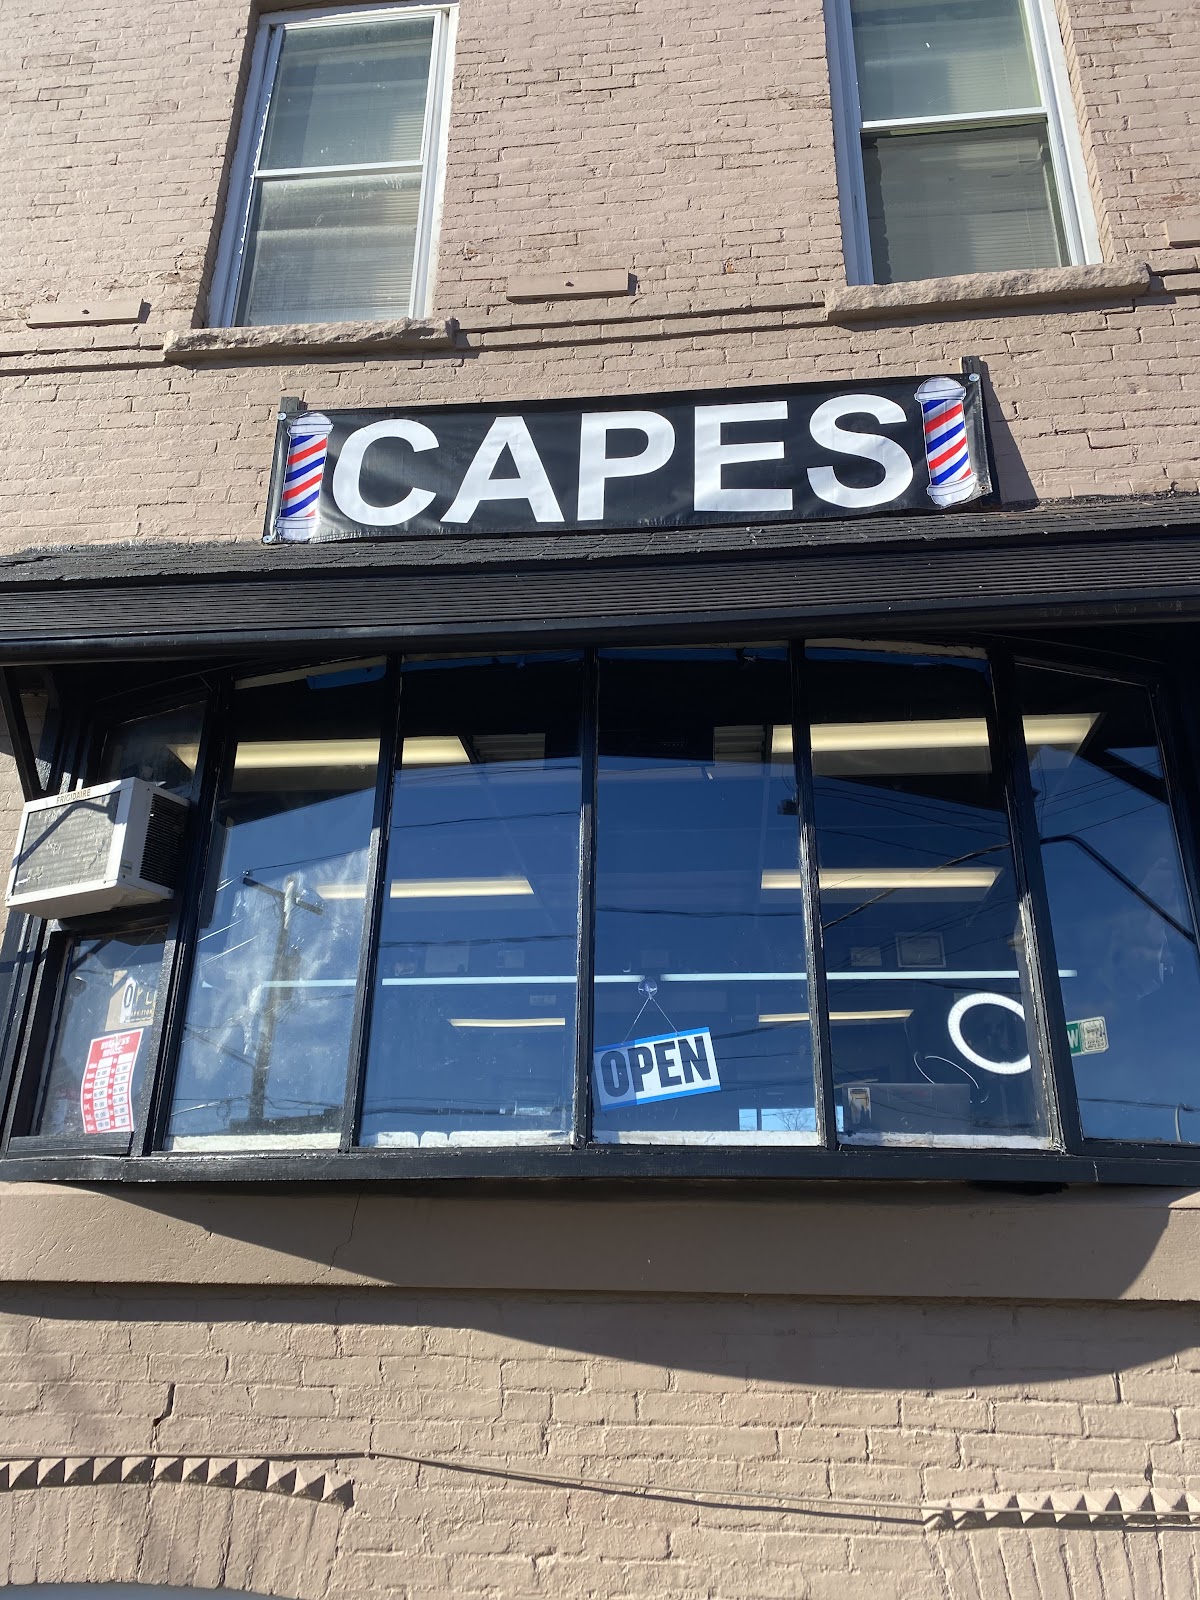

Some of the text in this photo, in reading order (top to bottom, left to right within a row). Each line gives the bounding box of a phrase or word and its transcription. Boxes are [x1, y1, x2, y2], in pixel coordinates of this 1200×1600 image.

[332, 394, 914, 527] CAPES
[57, 789, 91, 804] FRIGIDAIRE
[601, 1036, 711, 1097] OPEN
